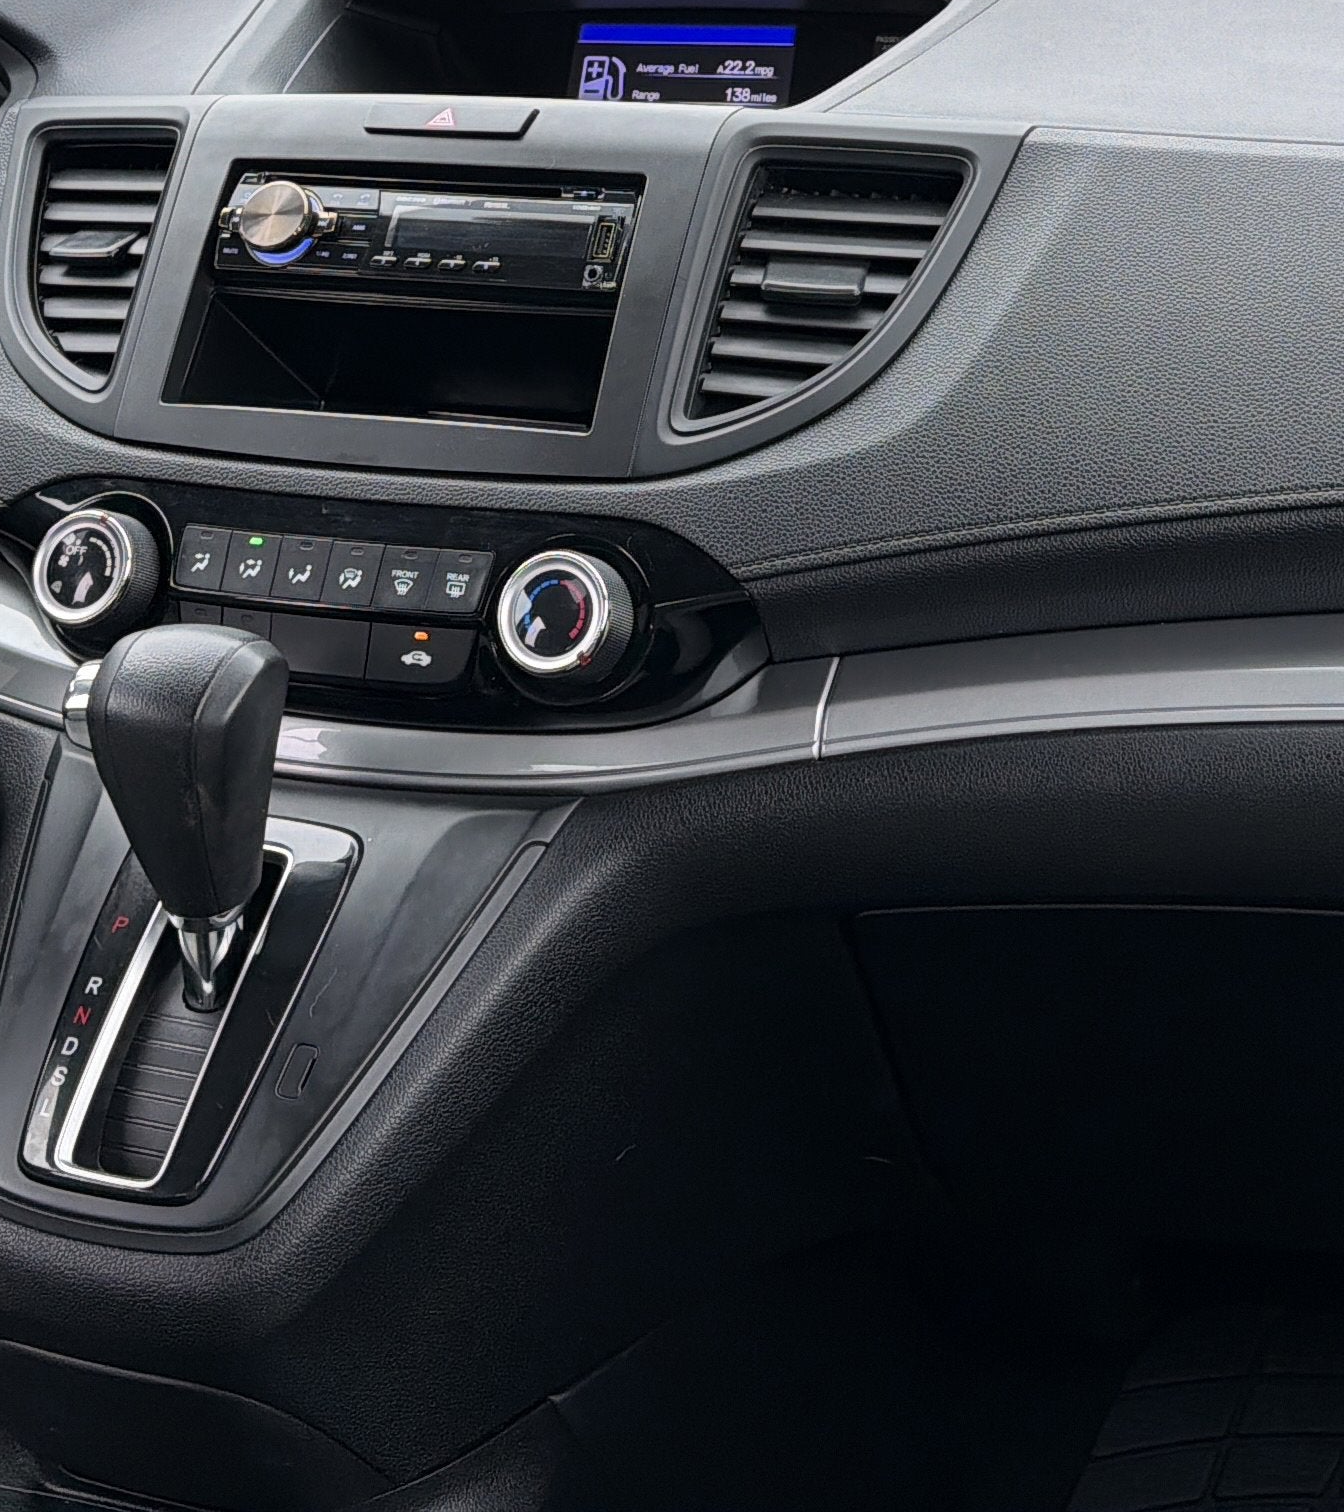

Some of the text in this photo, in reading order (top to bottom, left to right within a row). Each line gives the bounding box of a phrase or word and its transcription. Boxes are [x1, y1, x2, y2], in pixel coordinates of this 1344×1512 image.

[636, 63, 674, 75] Average
[678, 64, 699, 74] Fuel
[632, 90, 660, 101] Range
[66, 545, 88, 555] OFF
[391, 569, 471, 582] FRONT REAR
[111, 916, 130, 934] P
[85, 976, 103, 995] R
[73, 1005, 92, 1025] N
[61, 1036, 79, 1056] D
[51, 1066, 69, 1087] S
[39, 1098, 51, 1118] L
